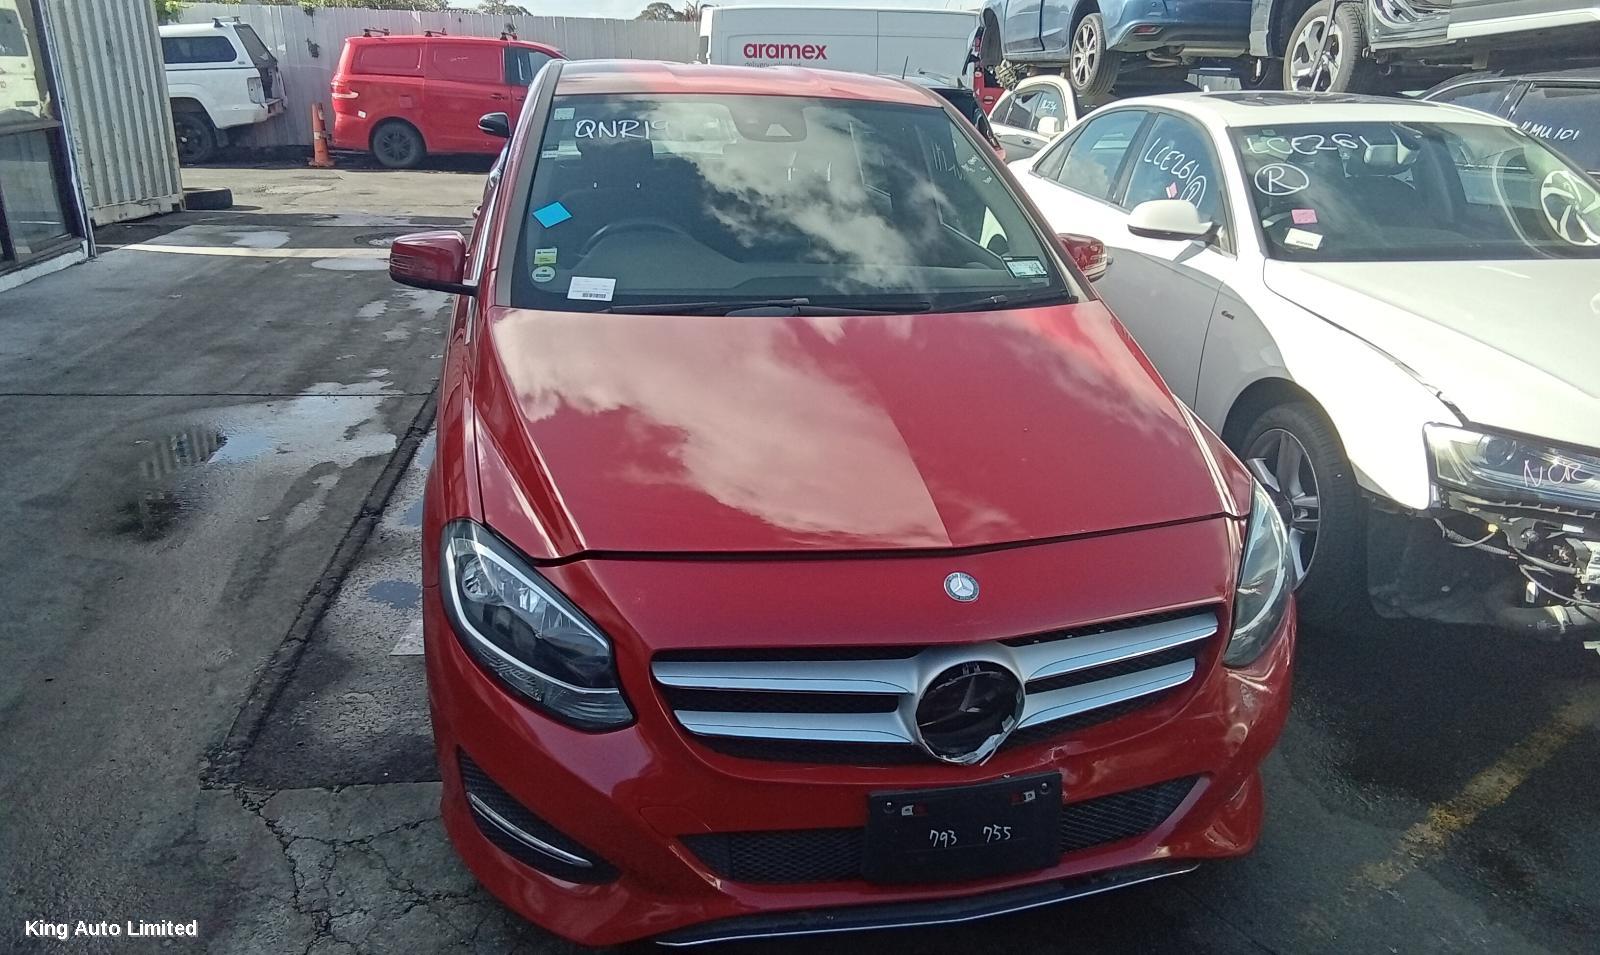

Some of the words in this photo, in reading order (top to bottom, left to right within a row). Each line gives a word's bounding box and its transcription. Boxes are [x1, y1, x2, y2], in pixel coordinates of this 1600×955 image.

[744, 43, 827, 60] aramex
[1247, 134, 1370, 154] LCE261
[1144, 137, 1199, 184] LCE261
[929, 829, 958, 849] 793
[983, 824, 1012, 843] 755
